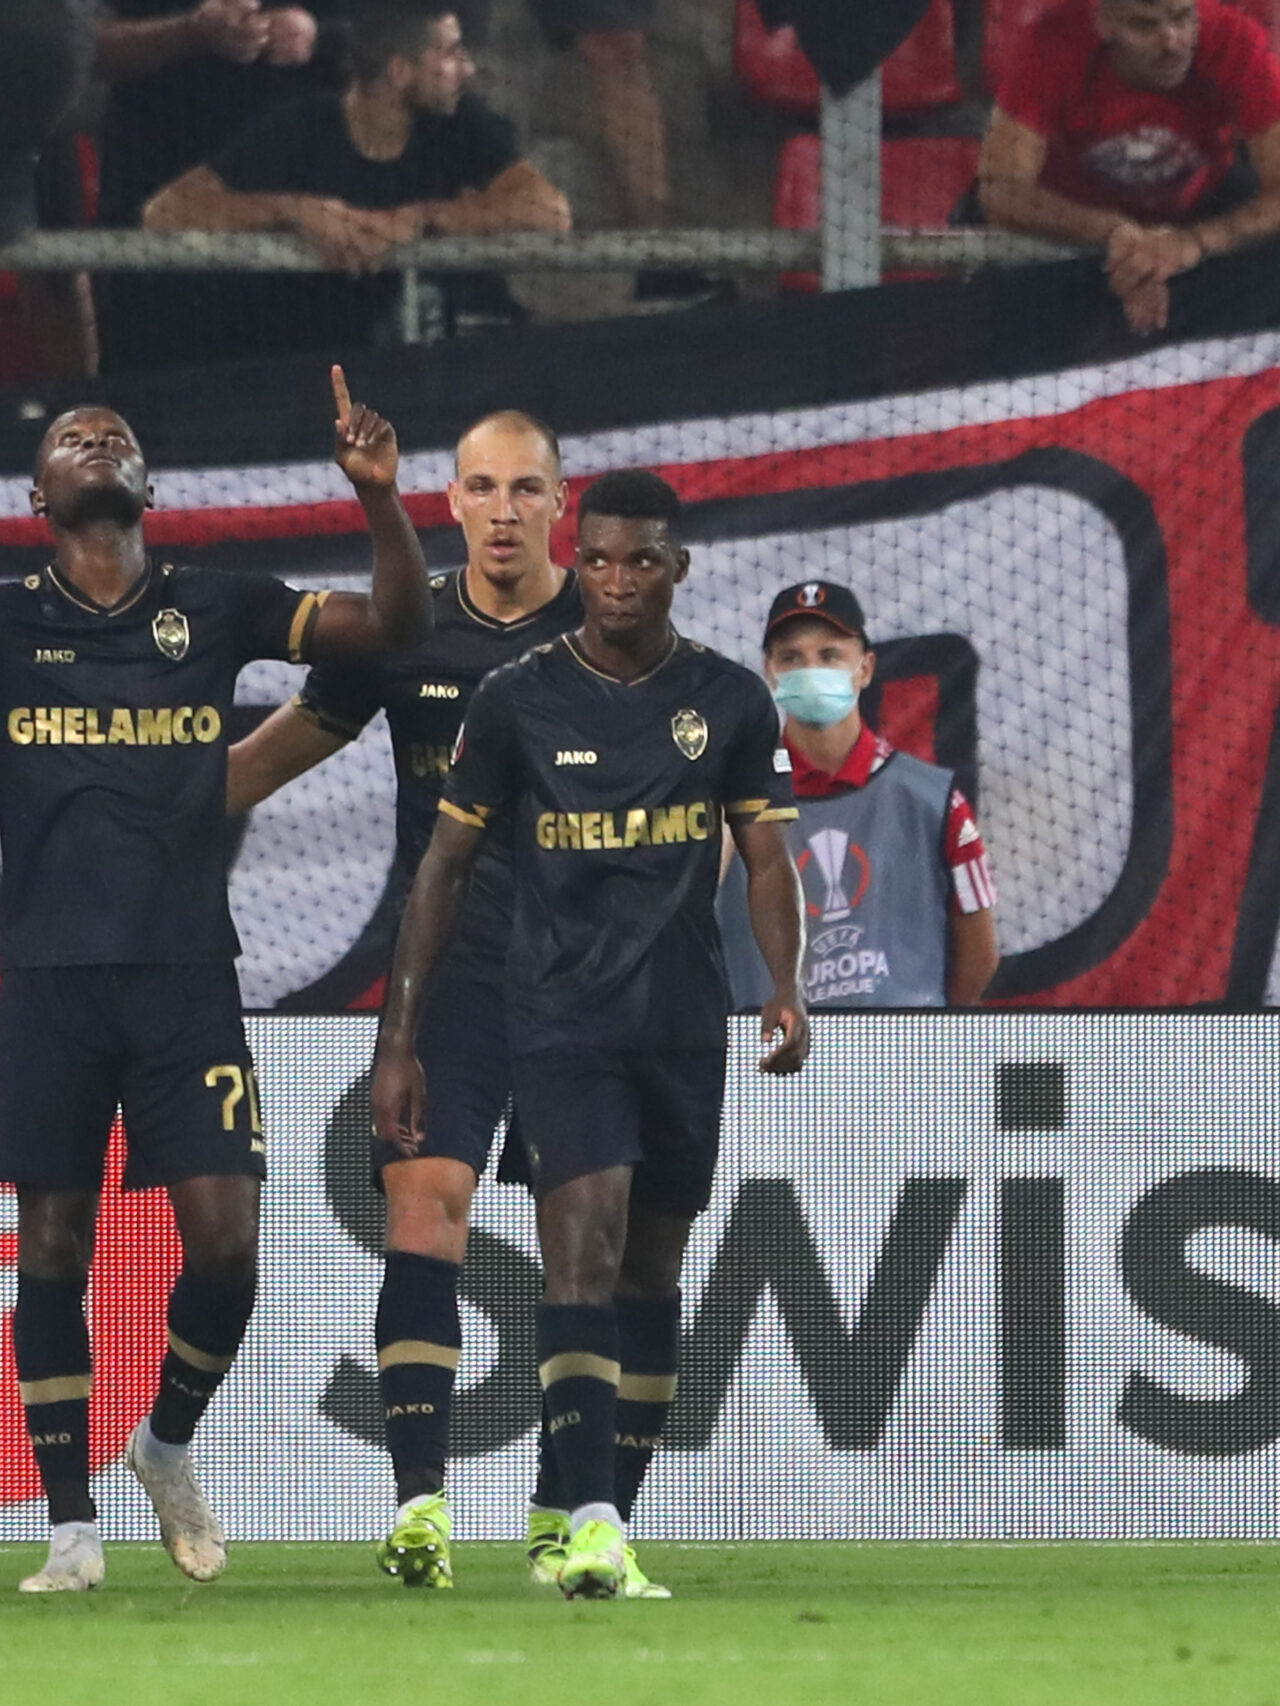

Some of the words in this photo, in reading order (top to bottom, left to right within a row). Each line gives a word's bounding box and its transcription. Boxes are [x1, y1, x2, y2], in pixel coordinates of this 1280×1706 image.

[34, 649, 76, 664] JAKO
[419, 684, 460, 699] JAKO
[7, 705, 221, 745] GHELAMCO
[554, 751, 598, 766] JAKO
[549, 1410, 582, 1434] AKO
[32, 1432, 72, 1447] AKO
